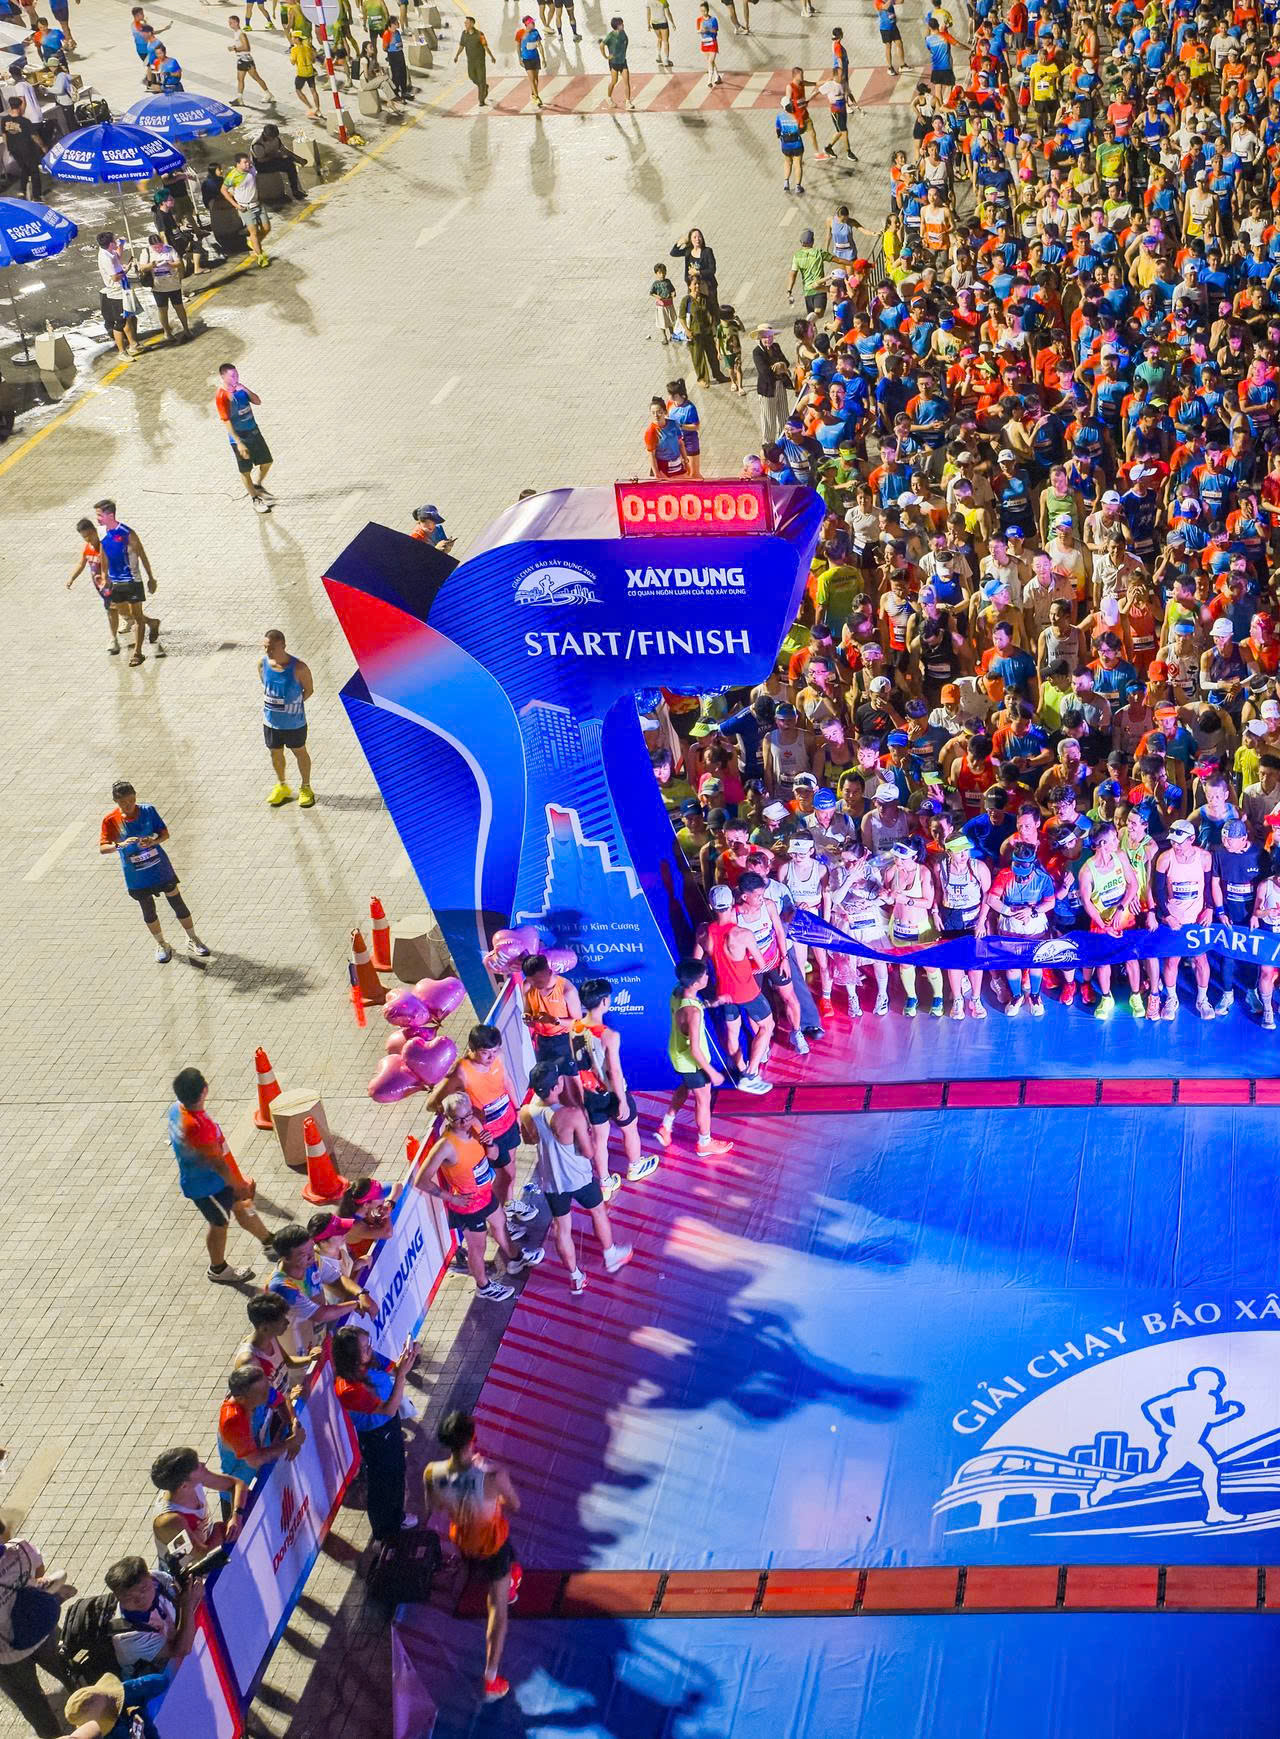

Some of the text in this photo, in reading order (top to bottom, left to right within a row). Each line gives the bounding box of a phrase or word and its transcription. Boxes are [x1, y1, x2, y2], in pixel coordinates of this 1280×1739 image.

[102, 147, 139, 157] POCARI
[104, 152, 136, 160] SWEAT
[6, 220, 42, 234] POCARI
[10, 227, 42, 240] SWEAT
[623, 493, 759, 522] 0:00:00
[524, 629, 751, 659] START/FINISH
[590, 922, 608, 930] Kim
[610, 922, 640, 932] Cương
[596, 942, 644, 953] OANH
[1185, 927, 1265, 956] START
[621, 975, 641, 984] Hành
[608, 1004, 644, 1012] ongtam
[951, 1375, 1027, 1435] GIẢI
[1027, 1321, 1127, 1379] CHẠY
[1142, 1301, 1222, 1335] BÁO
